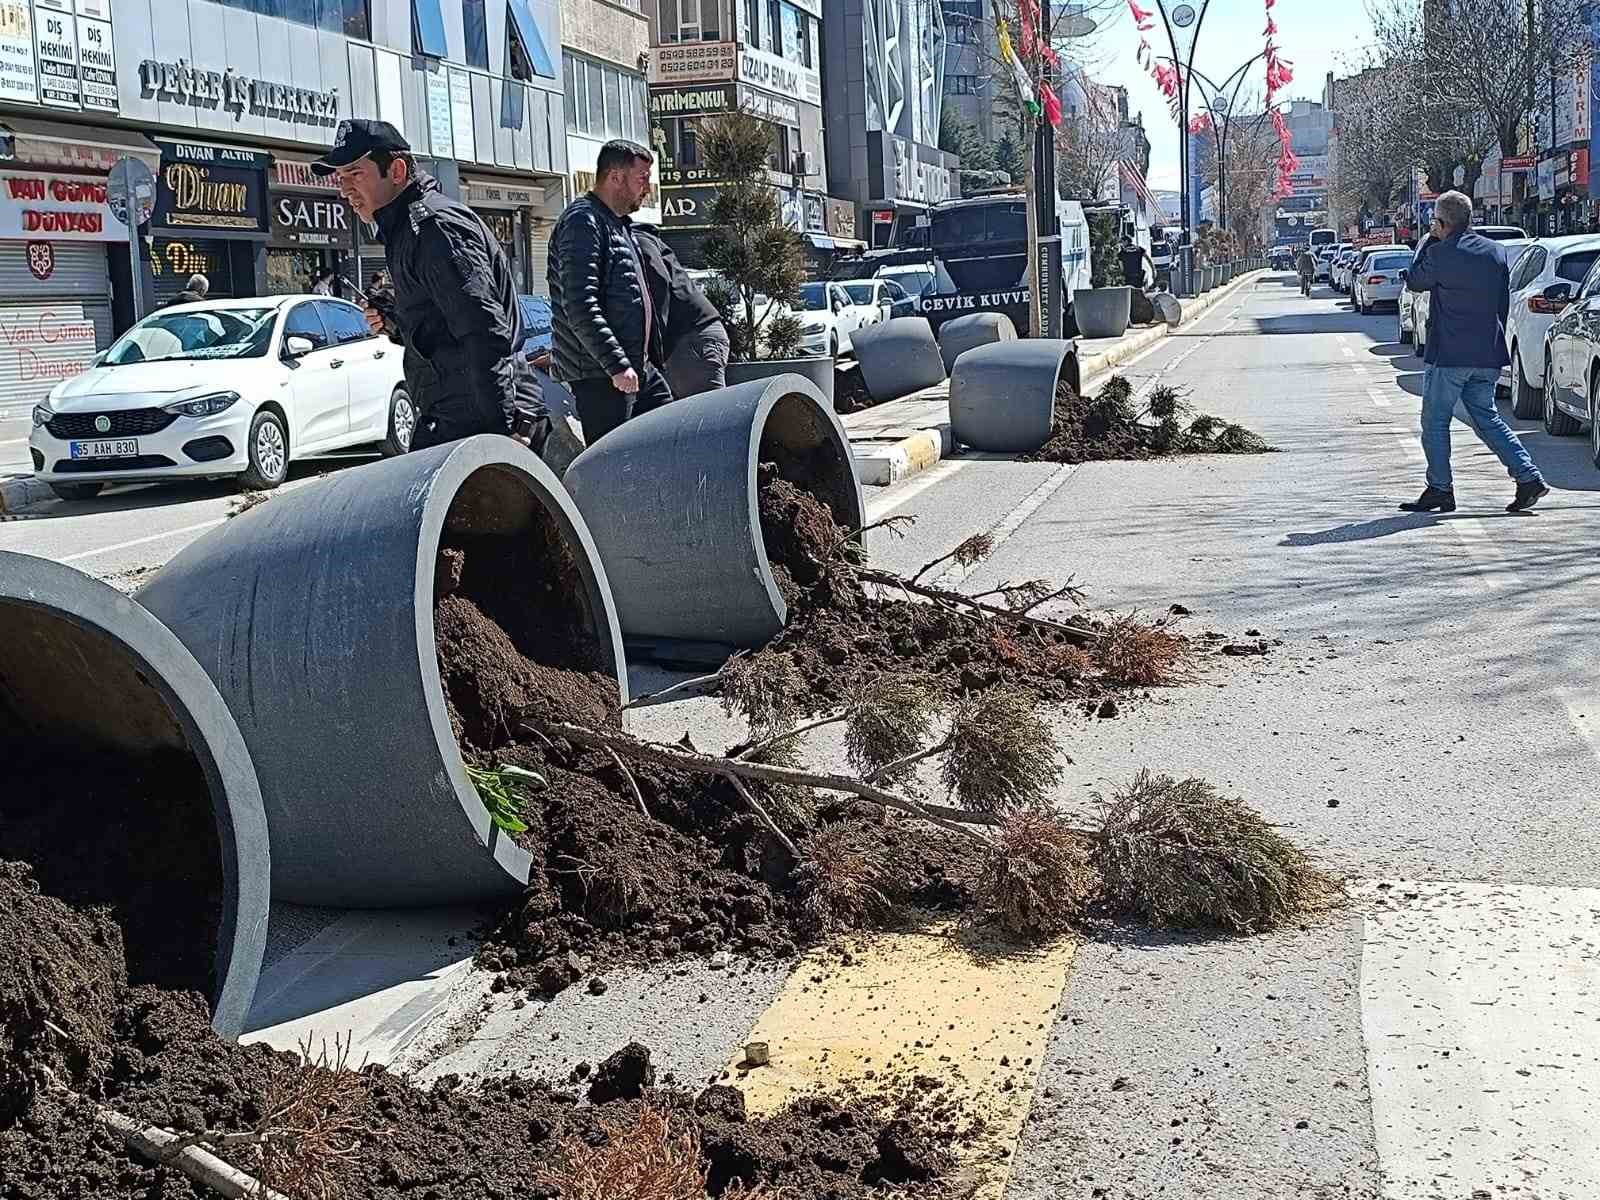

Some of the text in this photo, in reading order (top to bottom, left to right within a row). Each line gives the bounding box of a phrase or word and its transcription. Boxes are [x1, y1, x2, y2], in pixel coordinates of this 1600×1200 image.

[47, 16, 62, 40] DİŞ
[87, 24, 102, 48] DİŞ
[40, 40, 73, 60] HEKİMİ
[81, 47, 112, 67] HEKİMİ
[138, 58, 340, 127] DEĞER İŞ MERKEZİ
[652, 89, 729, 111] AYRİMENKUL
[176, 144, 254, 161] DİVAN ALTIN
[5, 178, 109, 203] VAN GÜMÜ
[24, 209, 102, 232] DÜNYASI
[278, 199, 347, 230] SAFİR
[922, 291, 1031, 313] ÇEVİK KUVVE
[77, 441, 135, 456] 65 AAH 830
